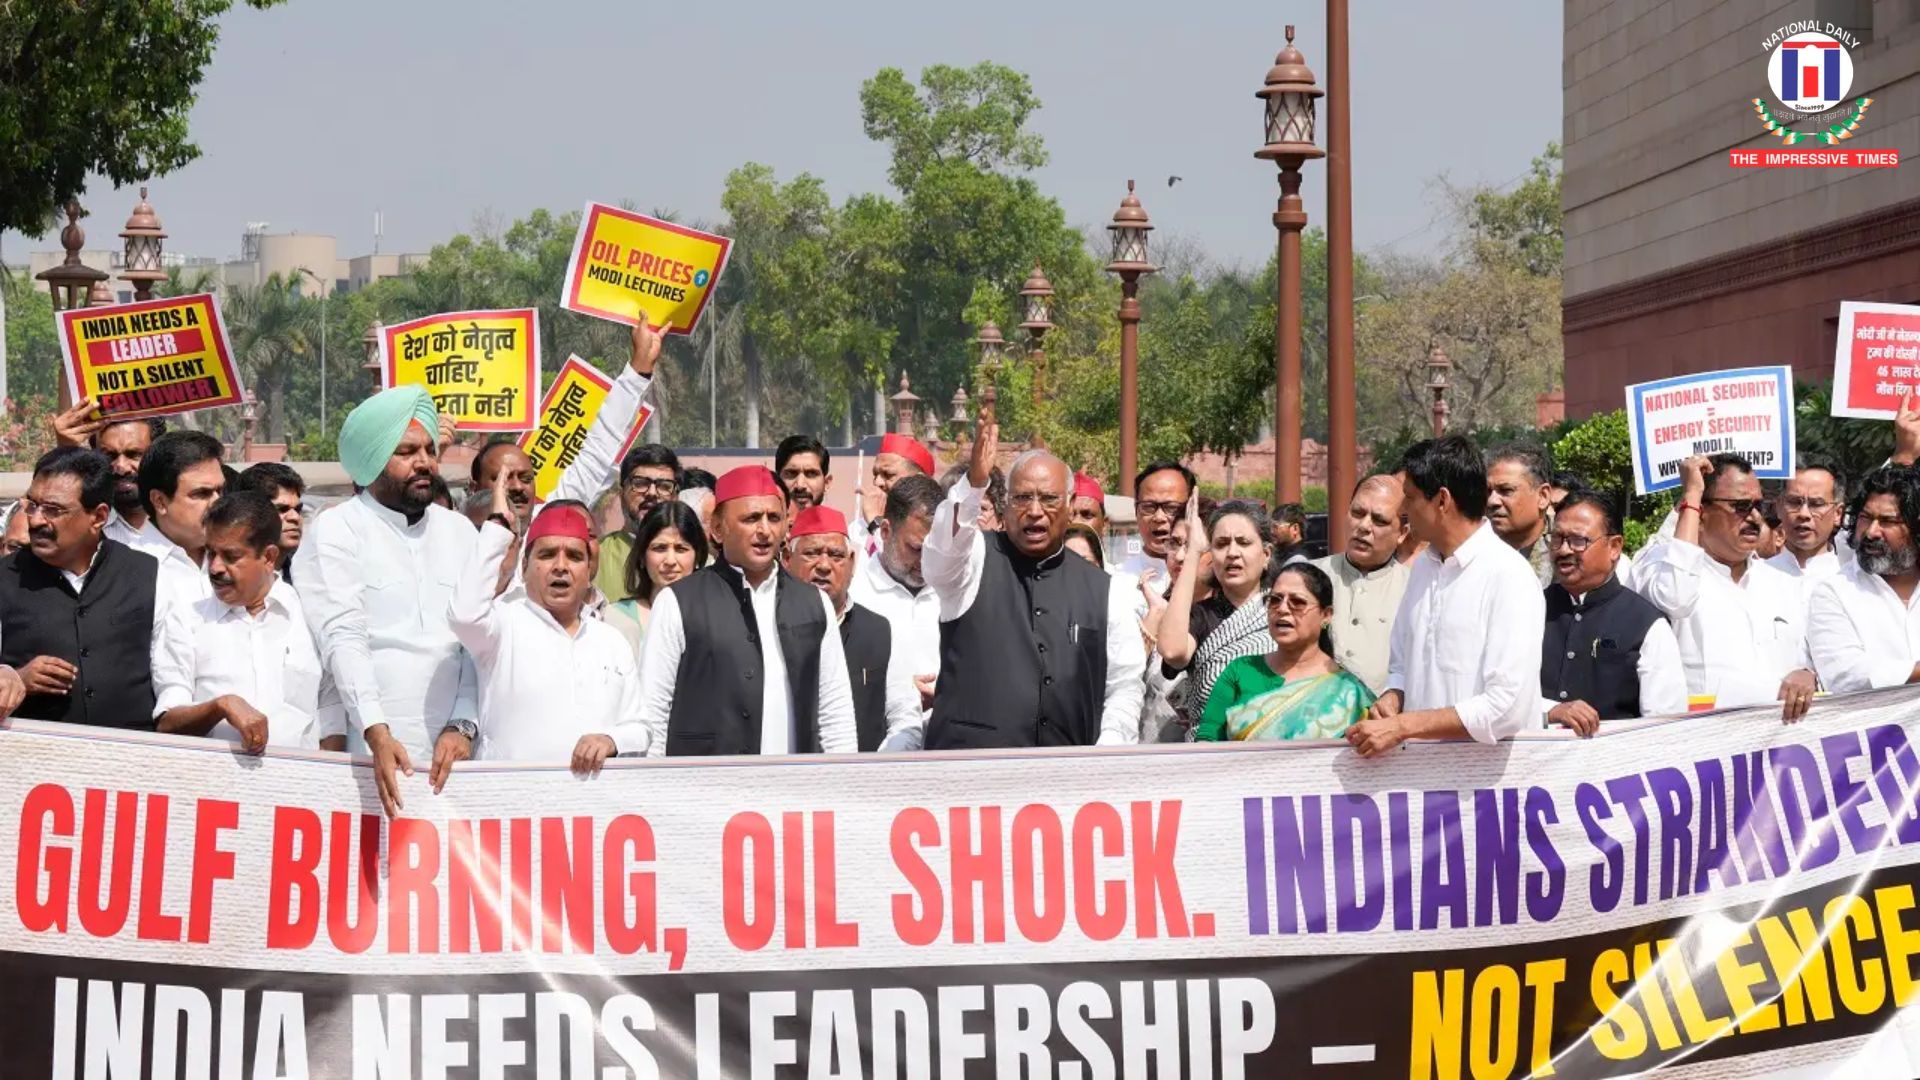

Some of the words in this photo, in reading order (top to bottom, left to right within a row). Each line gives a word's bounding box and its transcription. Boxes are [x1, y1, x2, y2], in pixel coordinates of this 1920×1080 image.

[591, 240, 622, 266] OIL
[627, 249, 694, 286] PRICES
[588, 264, 623, 286] MODI
[624, 276, 686, 303] LECTURES
[82, 317, 128, 340] INDIA
[130, 309, 183, 334] NEEDS
[185, 307, 199, 325] A
[110, 333, 178, 362] LEADER
[402, 333, 430, 360] देश
[432, 324, 458, 352] को
[461, 322, 516, 361] नेतृत्व
[96, 370, 129, 391] NOT
[133, 369, 145, 387] A
[148, 358, 205, 383] SILENT
[425, 355, 484, 387] चाहिए,
[473, 387, 519, 417] नहीं
[1645, 388, 1709, 413] NATIONAL
[1712, 381, 1776, 401] SECURITY
[535, 424, 560, 452] को
[548, 380, 587, 428] नेतृत्व
[1654, 421, 1704, 445] ENERGY
[1709, 415, 1771, 434] SECURITY
[1693, 438, 1723, 455] MODI
[15, 783, 240, 944] GULF
[266, 805, 687, 971] BURNING,
[722, 810, 859, 952] OIL
[890, 799, 1215, 946] SHOCK.
[1243, 785, 1566, 936] INDIANS
[52, 977, 311, 1080] INDIA
[351, 991, 661, 1080] NEEDS
[695, 977, 1277, 1080] LEADERSHIP
[1409, 958, 1567, 1080] NOT
[1589, 884, 1920, 1061] SILENCE
